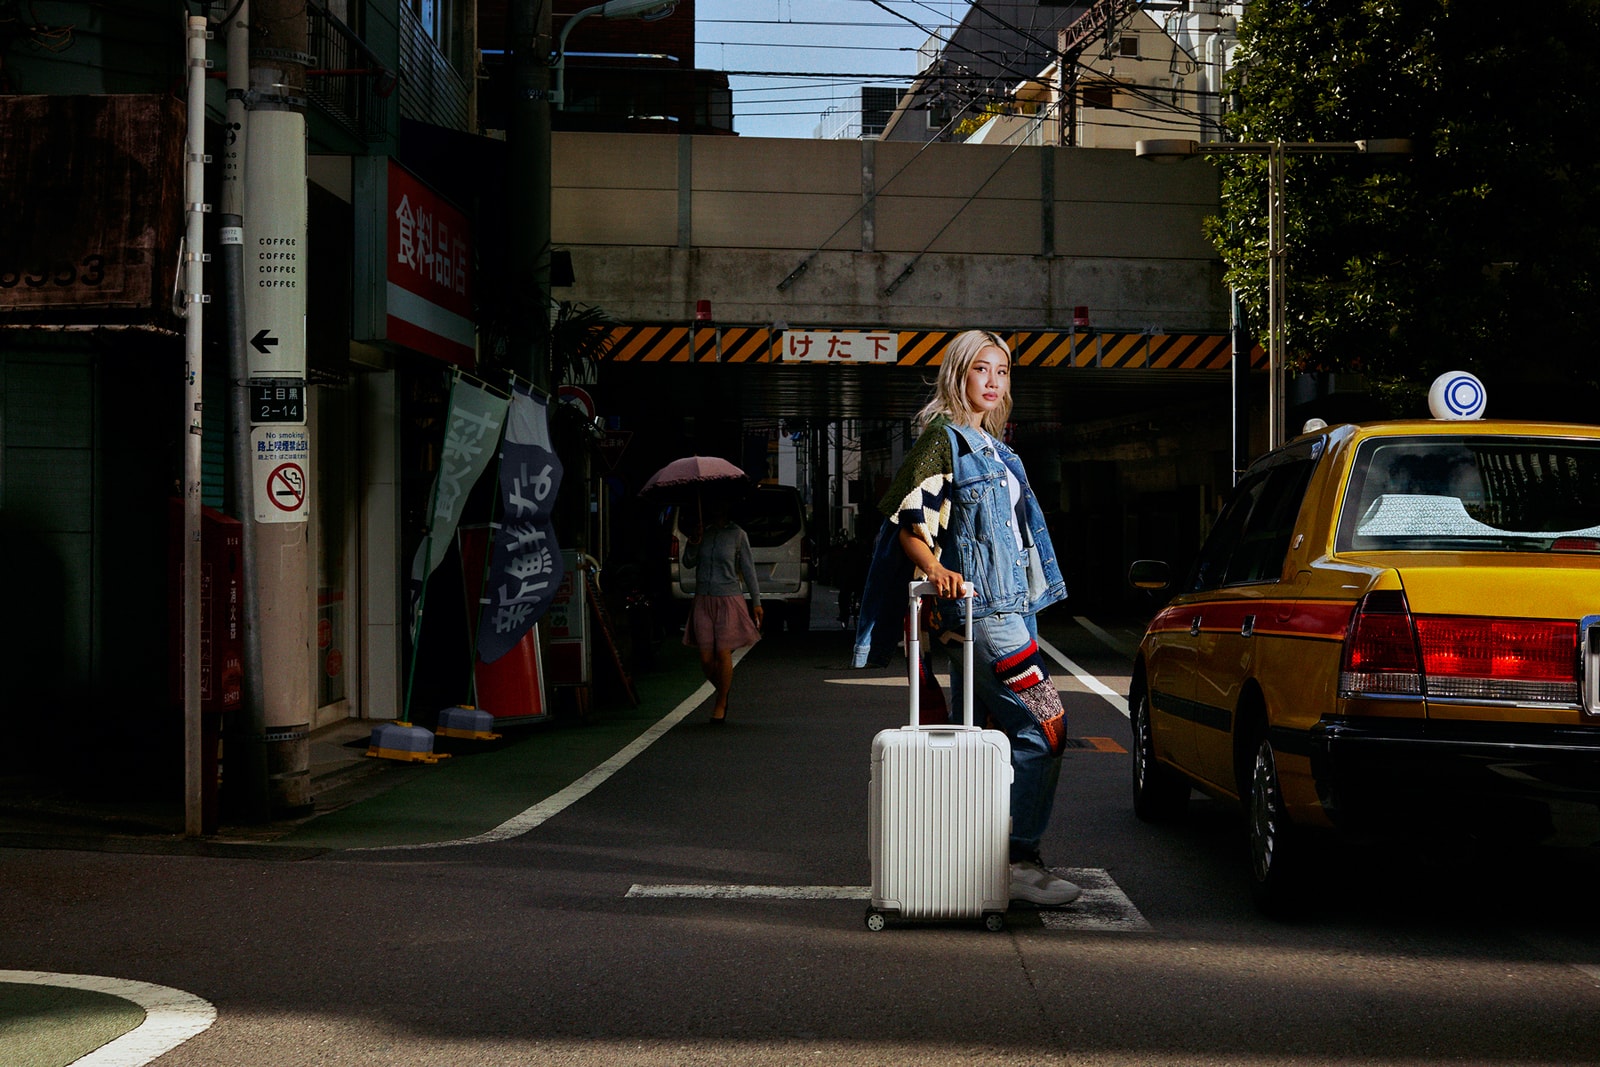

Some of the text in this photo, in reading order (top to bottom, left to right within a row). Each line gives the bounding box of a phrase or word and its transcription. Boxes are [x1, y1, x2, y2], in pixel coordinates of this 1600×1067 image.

[259, 238, 296, 246] COFFEE
[395, 193, 467, 296] 食料品店
[259, 252, 296, 261] COFFEE
[259, 265, 296, 274] COFFEE
[259, 280, 296, 288] COFFEE
[789, 334, 891, 359] けた下
[259, 387, 298, 400] 上目黒
[261, 404, 298, 417] 2-14
[491, 462, 554, 635] 新鮮な
